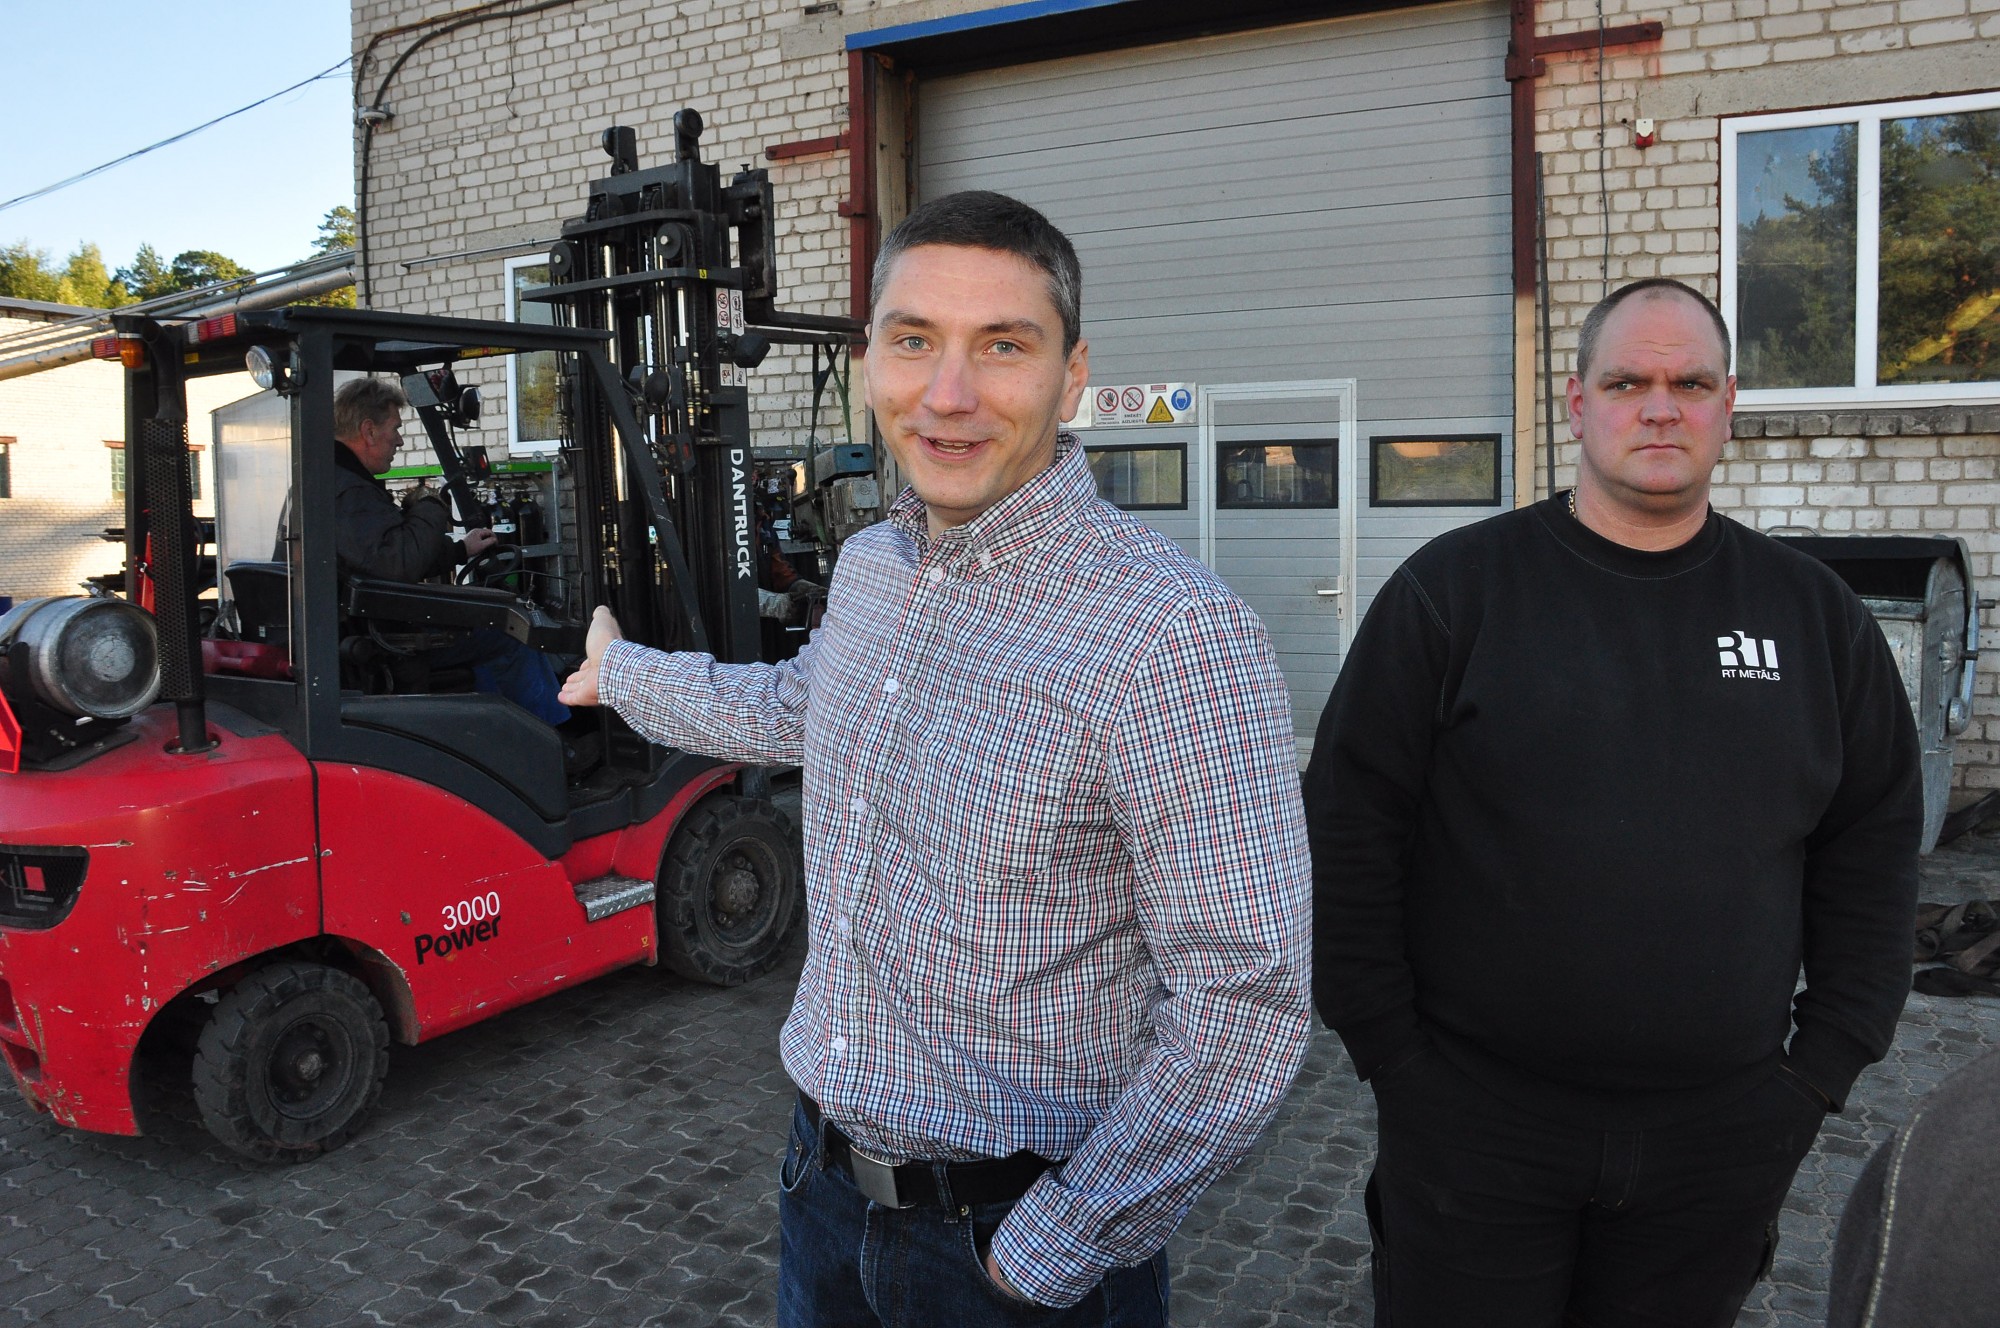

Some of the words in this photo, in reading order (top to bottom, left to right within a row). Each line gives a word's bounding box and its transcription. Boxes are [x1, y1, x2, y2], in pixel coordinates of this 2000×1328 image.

[730, 449, 751, 580] DANTRUCK
[1722, 669, 1737, 679] RT
[1739, 669, 1781, 681] METĀLS
[441, 891, 500, 931] 3000
[414, 915, 502, 966] Power
